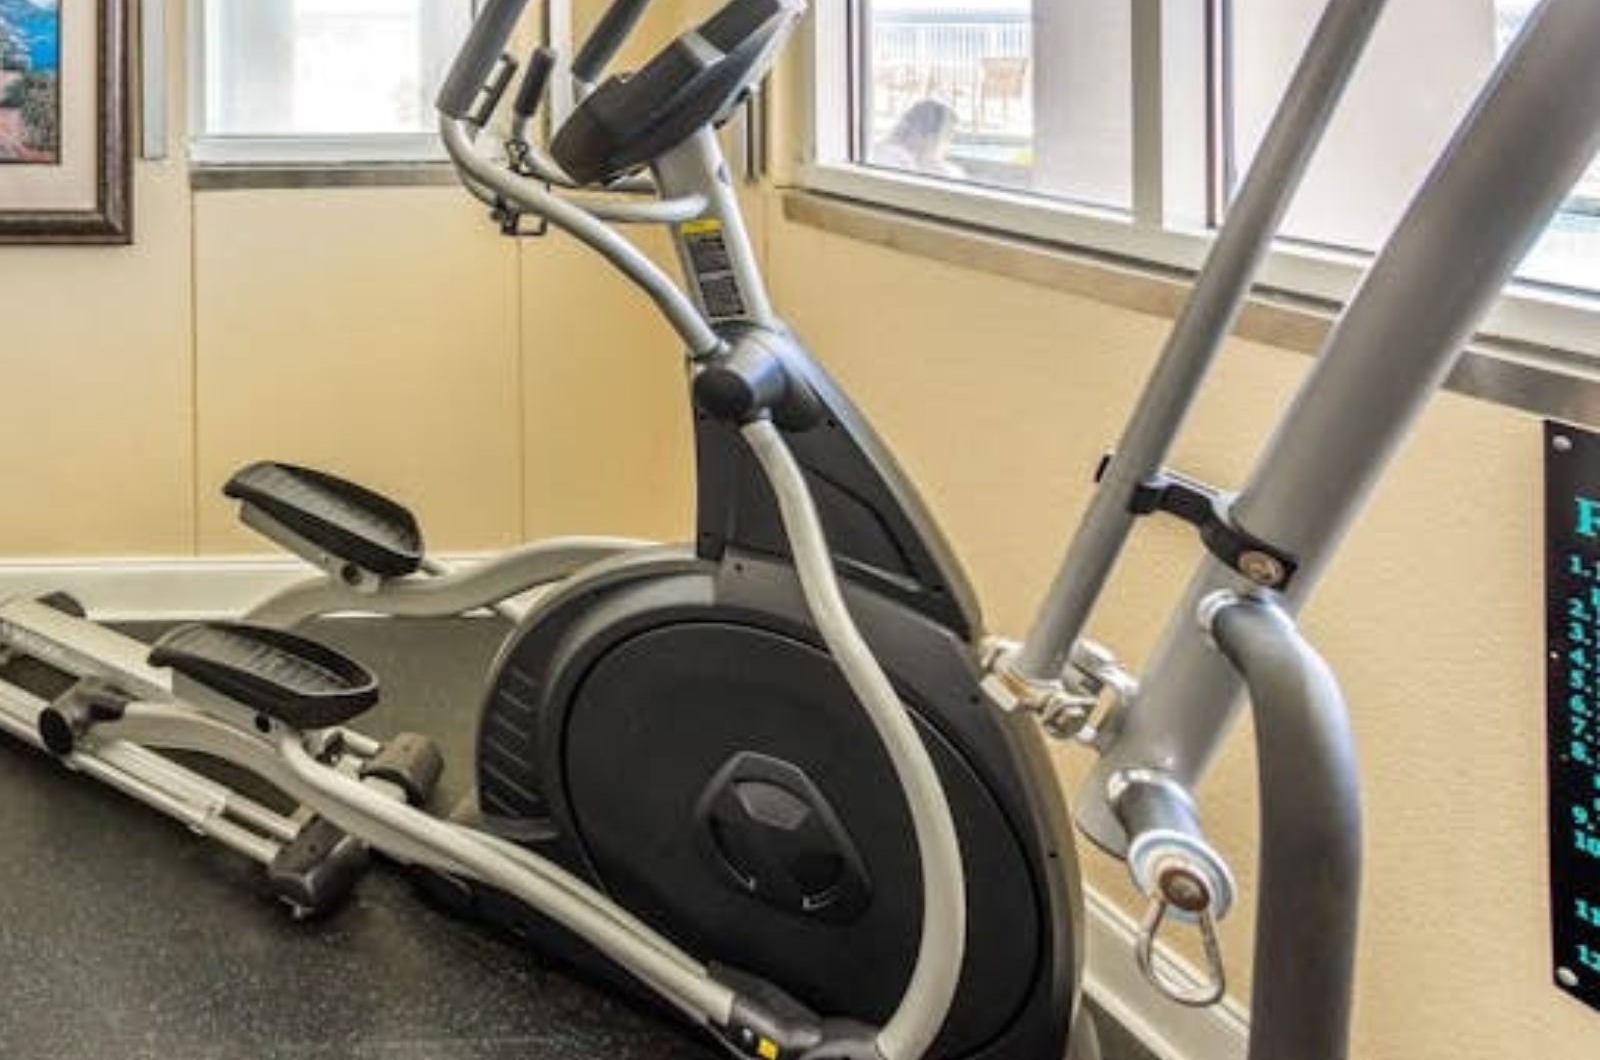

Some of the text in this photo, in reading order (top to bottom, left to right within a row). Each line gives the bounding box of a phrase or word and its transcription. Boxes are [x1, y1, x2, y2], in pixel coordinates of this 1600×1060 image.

[1570, 555, 1591, 577] 1.
[1568, 598, 1591, 620] 2.
[1568, 622, 1591, 645] 3.
[1568, 648, 1591, 668] 4.
[1568, 669, 1592, 692] 5.
[1570, 695, 1593, 717] 6.
[1570, 717, 1594, 742] 7.
[1571, 806, 1594, 829] 9.
